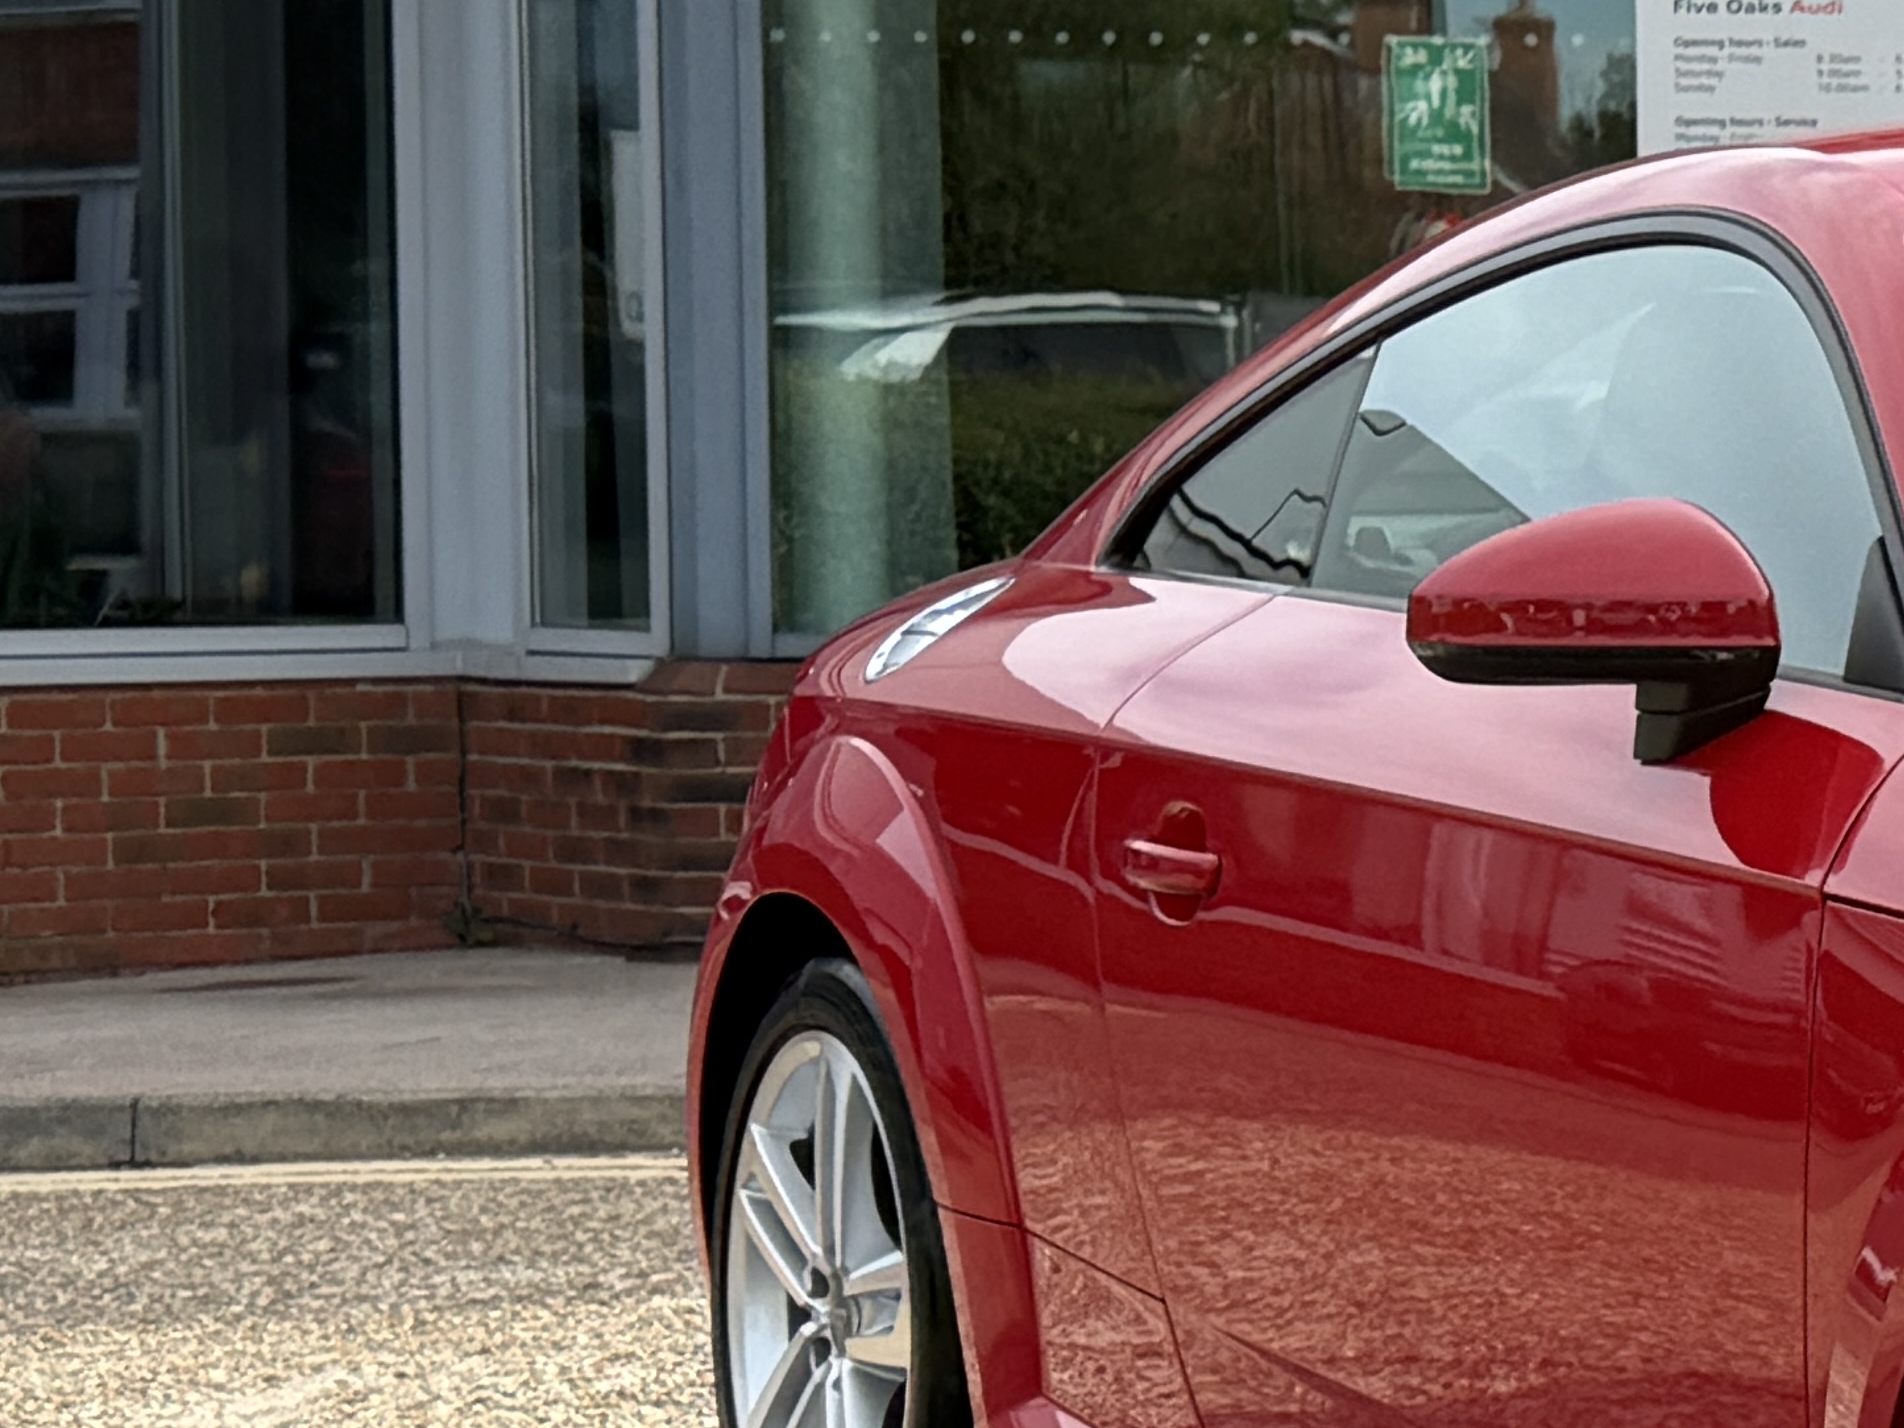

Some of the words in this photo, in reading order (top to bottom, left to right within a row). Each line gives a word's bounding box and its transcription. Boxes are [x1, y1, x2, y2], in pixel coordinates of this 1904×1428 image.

[1790, 0, 1844, 15] Audi
[1673, 37, 1725, 51] Opening
[1728, 37, 1764, 48] hours
[1773, 37, 1807, 48] Sales
[1673, 53, 1719, 65] Monday
[1674, 116, 1727, 130] Opening
[1729, 116, 1764, 127] hours
